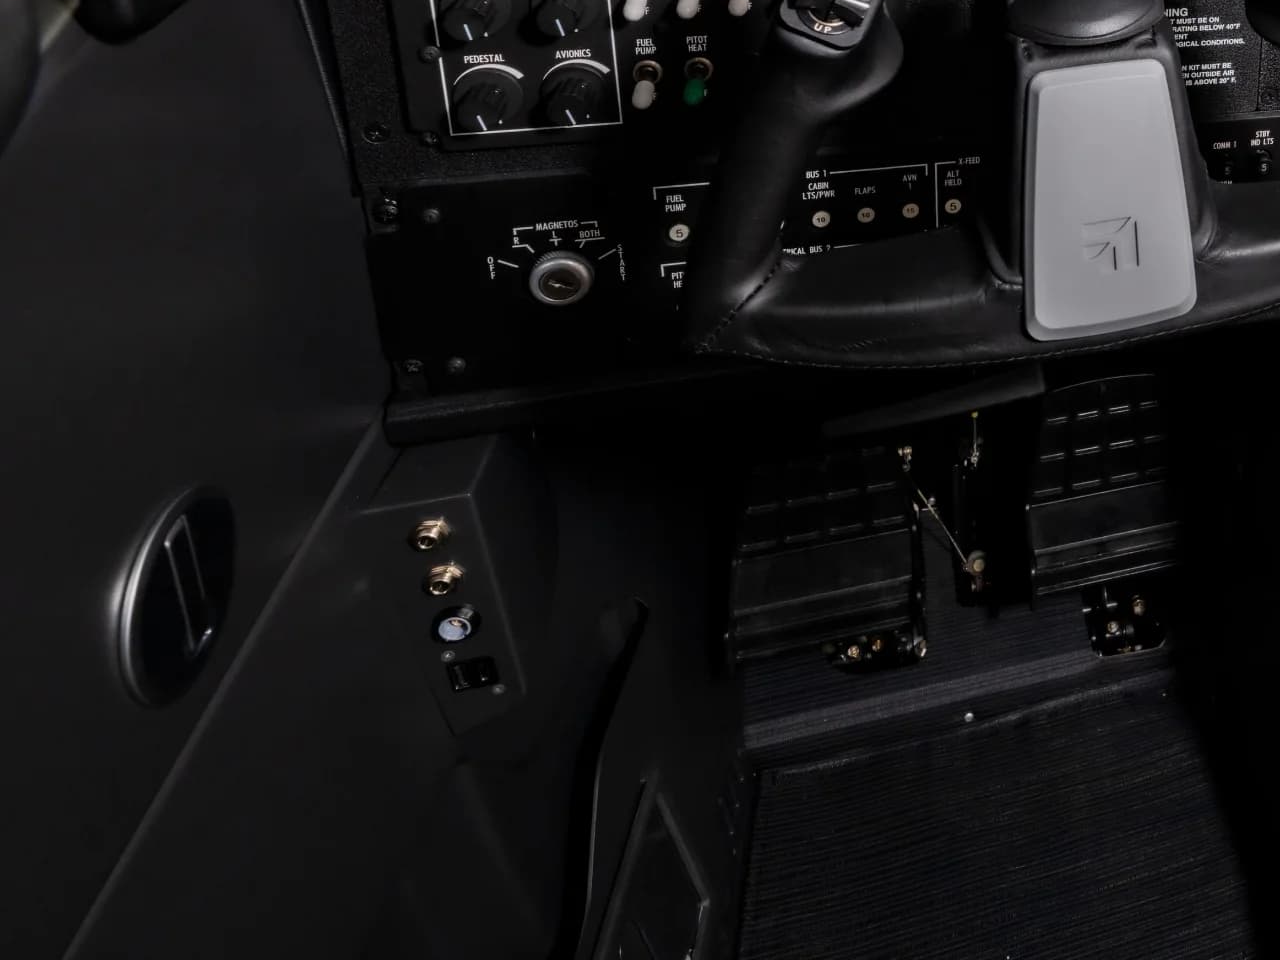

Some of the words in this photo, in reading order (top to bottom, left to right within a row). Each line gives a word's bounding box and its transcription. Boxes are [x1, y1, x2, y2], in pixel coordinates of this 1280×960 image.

[814, 23, 832, 33] UP
[636, 38, 654, 48] FUEL
[555, 48, 592, 59] AVIONICS
[635, 45, 657, 56] PUMP
[463, 53, 505, 65] PEDESTAL
[808, 182, 830, 191] CABIN
[854, 186, 876, 195] FLAPS
[665, 194, 685, 204] FUEL
[802, 190, 835, 200] LTS/PWR
[665, 202, 687, 213] PUMP
[536, 220, 579, 231] MAGNETOS
[579, 230, 600, 239] BOTH
